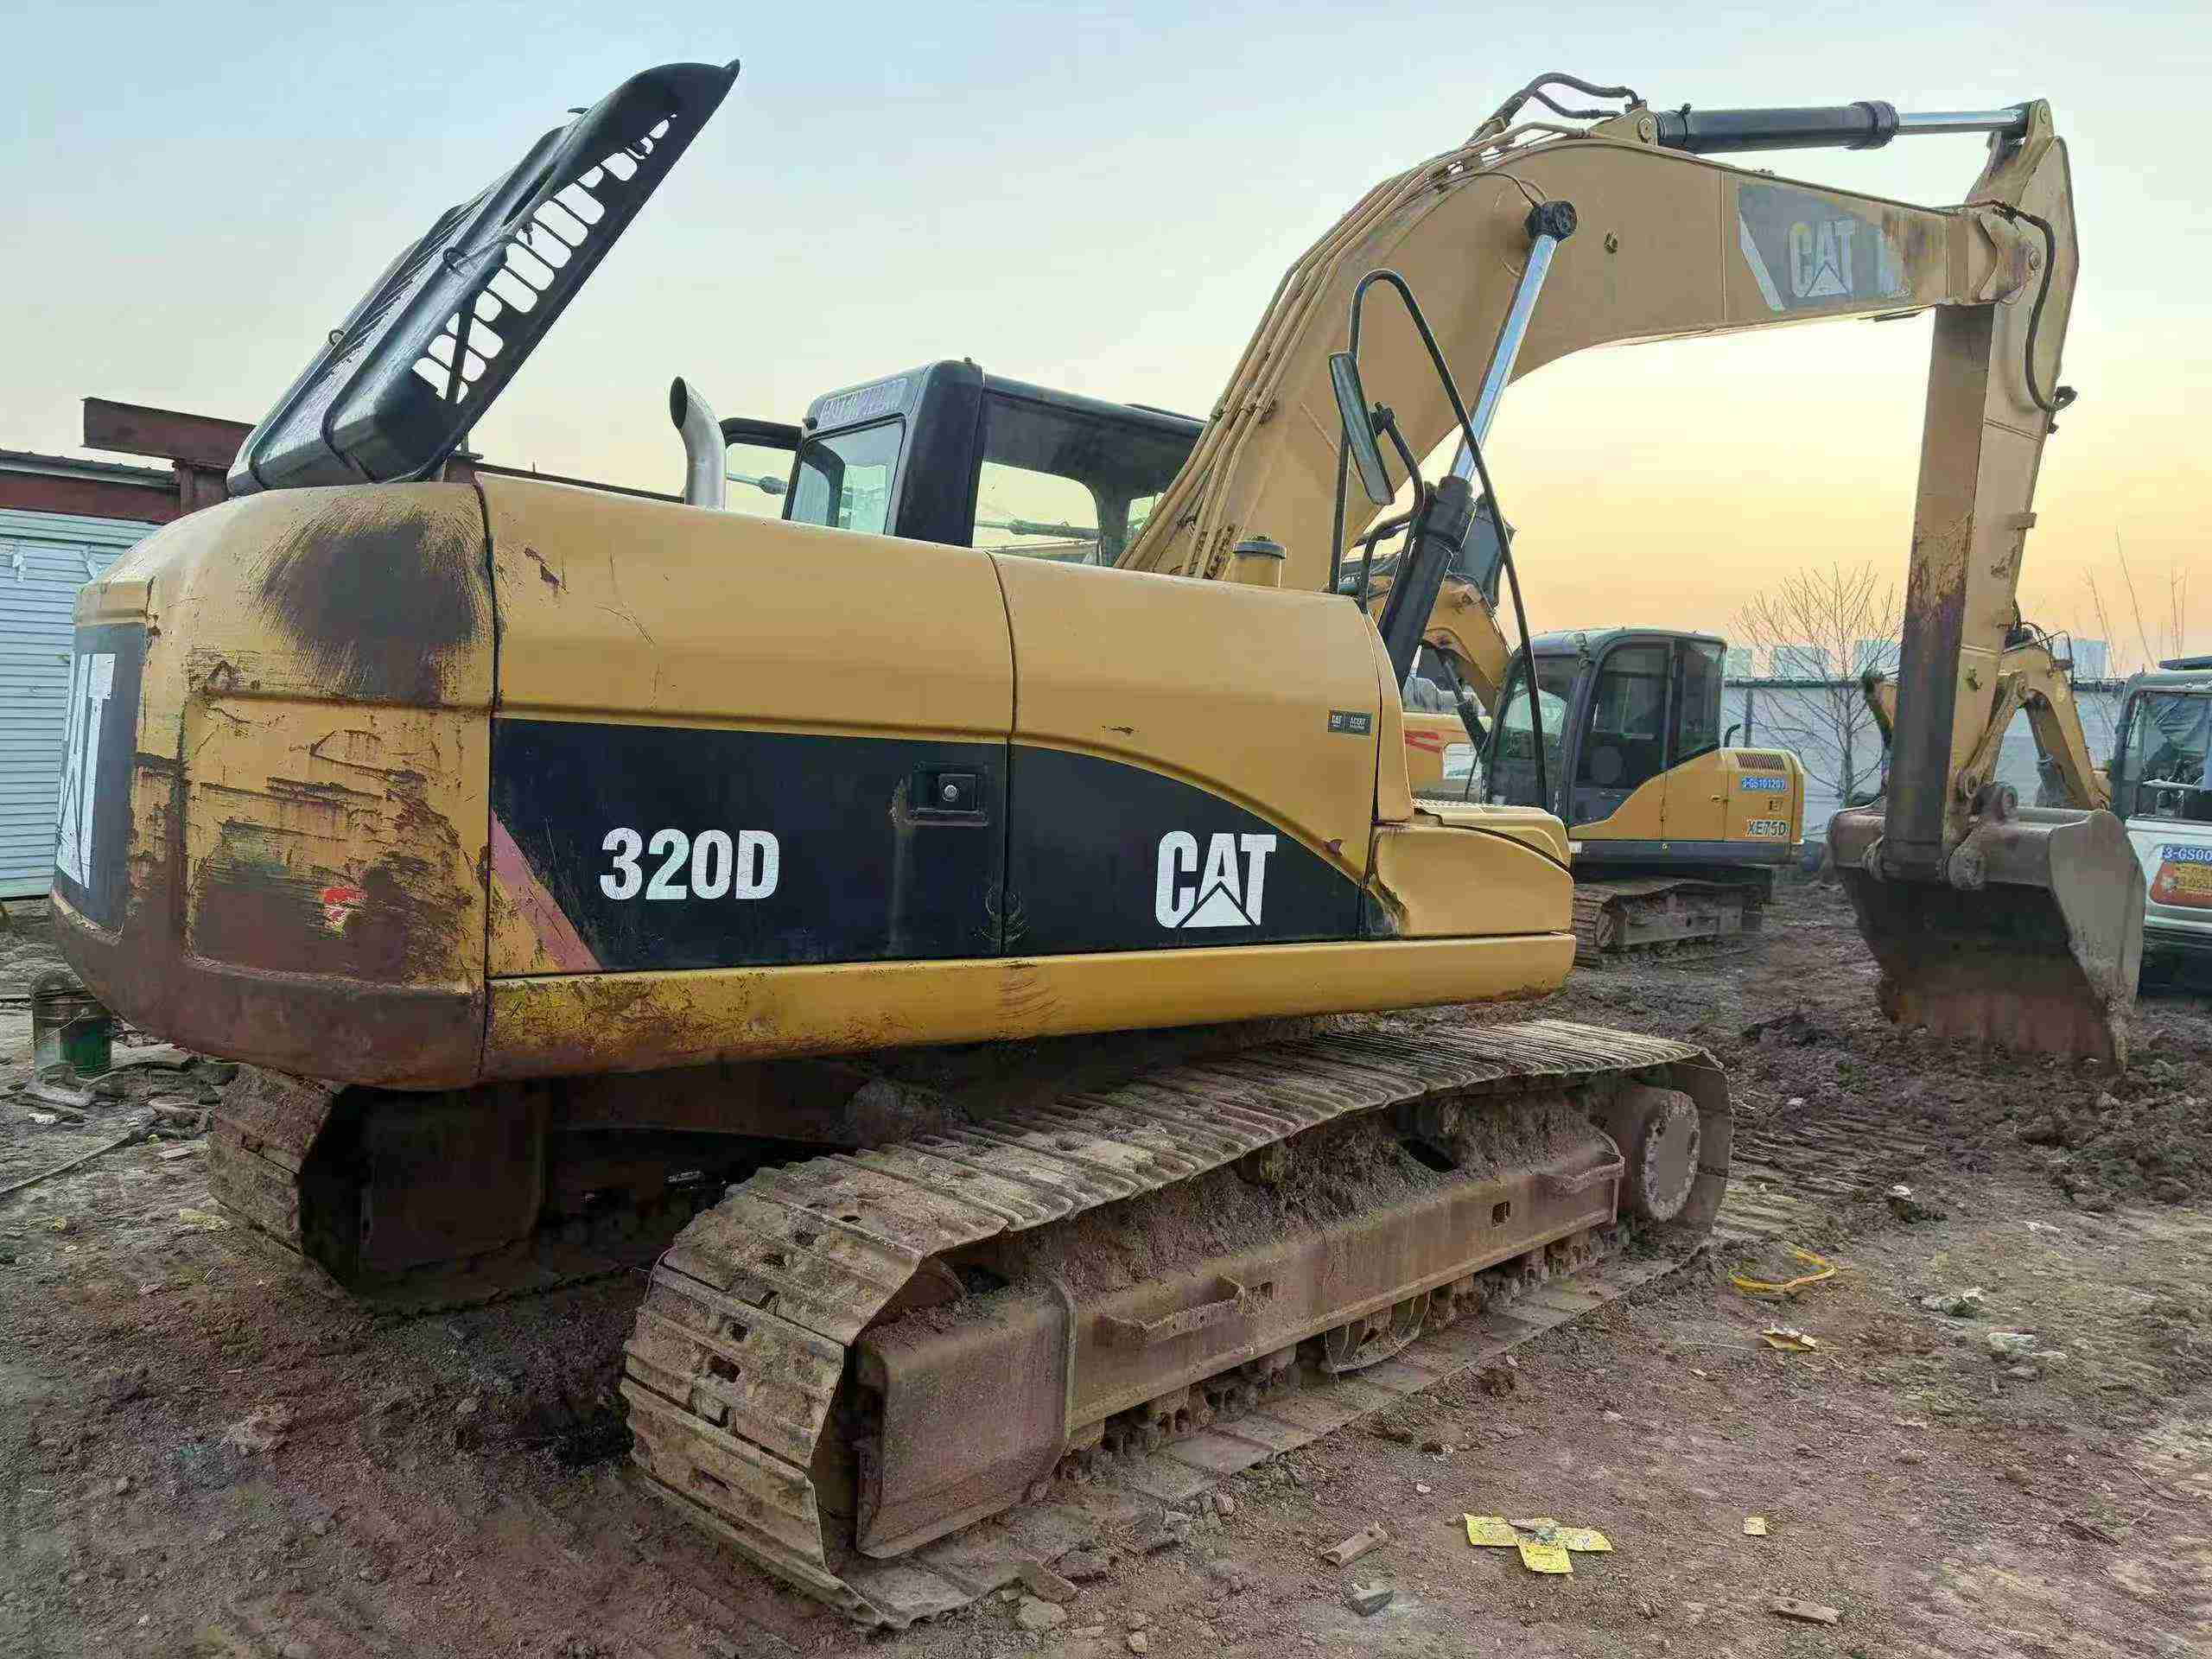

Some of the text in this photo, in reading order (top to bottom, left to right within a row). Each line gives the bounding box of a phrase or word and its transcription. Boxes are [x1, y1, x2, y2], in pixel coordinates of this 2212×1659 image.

[1789, 216, 1854, 298] CAT
[600, 827, 779, 900] 320D
[1155, 830, 1277, 928] CAT
